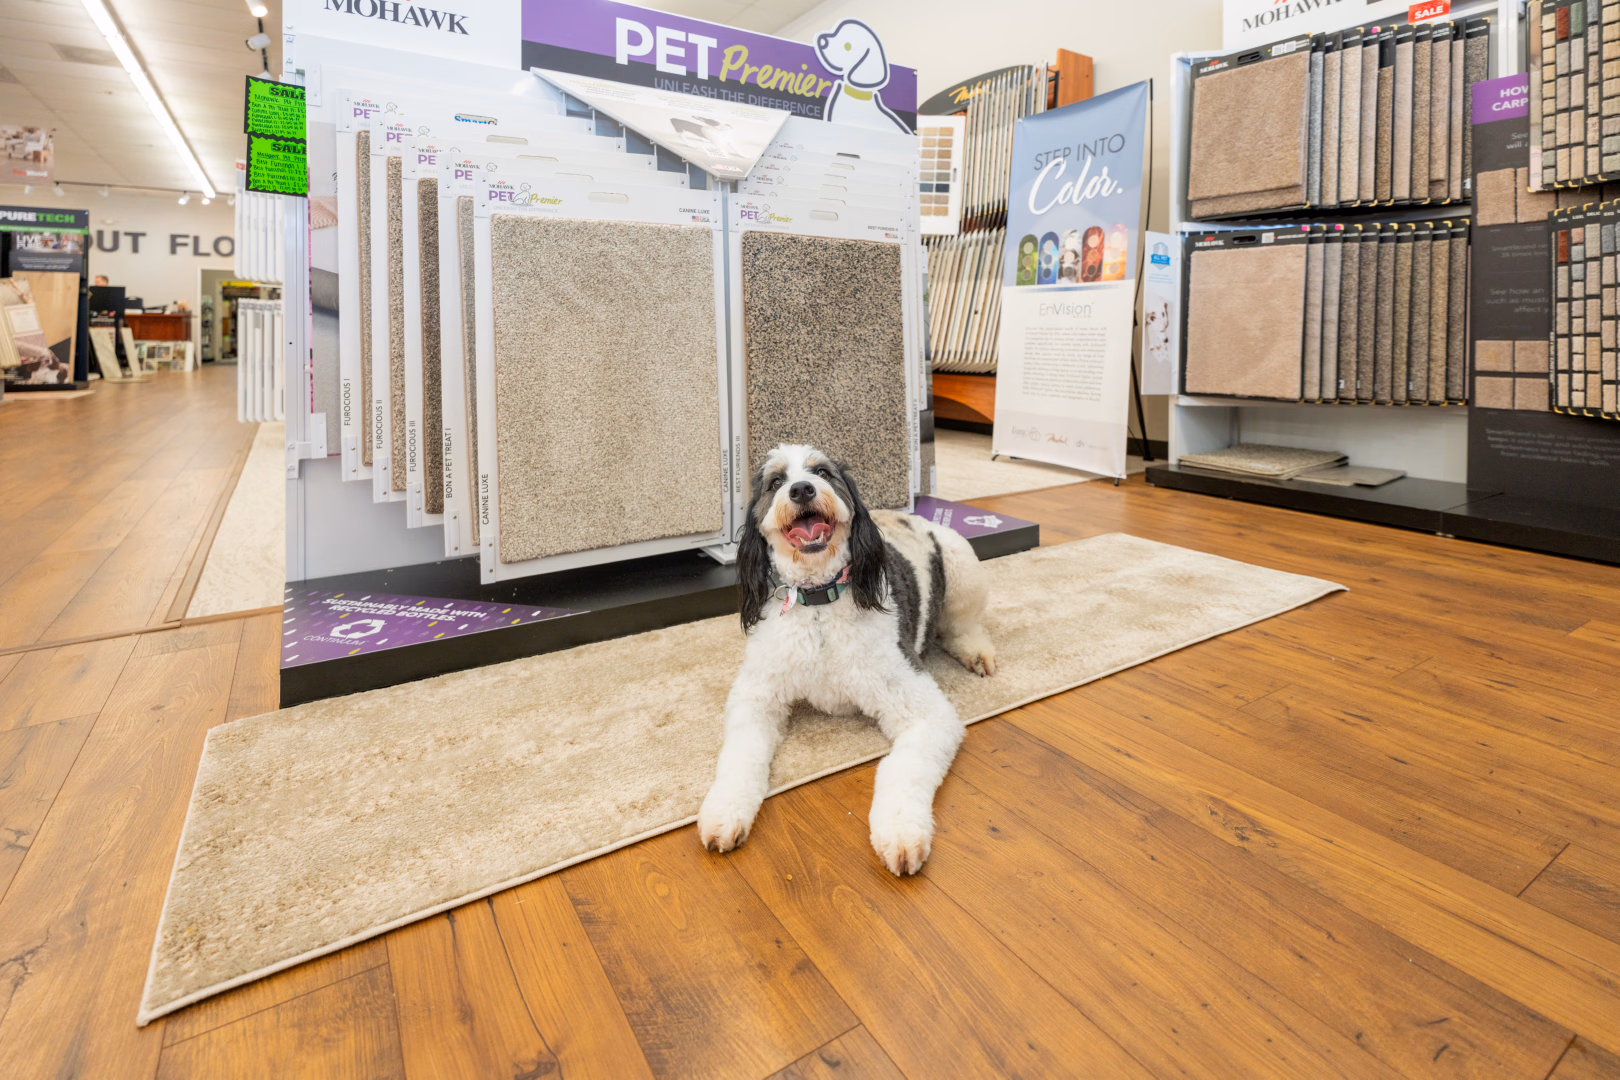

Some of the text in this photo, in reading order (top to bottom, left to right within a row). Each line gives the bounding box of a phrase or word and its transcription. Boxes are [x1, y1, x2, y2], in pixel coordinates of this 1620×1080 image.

[1414, 6, 1444, 19] SALE
[616, 17, 833, 98] PET Premier
[654, 77, 718, 98] UNLEASH
[720, 89, 745, 105] THE
[748, 95, 822, 117] DIFFERENCE
[1492, 97, 1529, 111] CARP
[1033, 133, 1126, 171] STEP INTO
[489, 183, 515, 191] MOHAWK
[489, 190, 563, 206] PET Premier
[741, 209, 760, 220] PET
[343, 382, 351, 426] FUROCIOUS
[409, 429, 417, 472] FUROCIOUS
[444, 432, 452, 456] TREAT
[445, 480, 453, 498] BON
[481, 473, 490, 526] CANINE LUXE
[322, 597, 488, 620] SUSTAINABLY MADE WITH
[328, 603, 402, 619] RECYCLED
